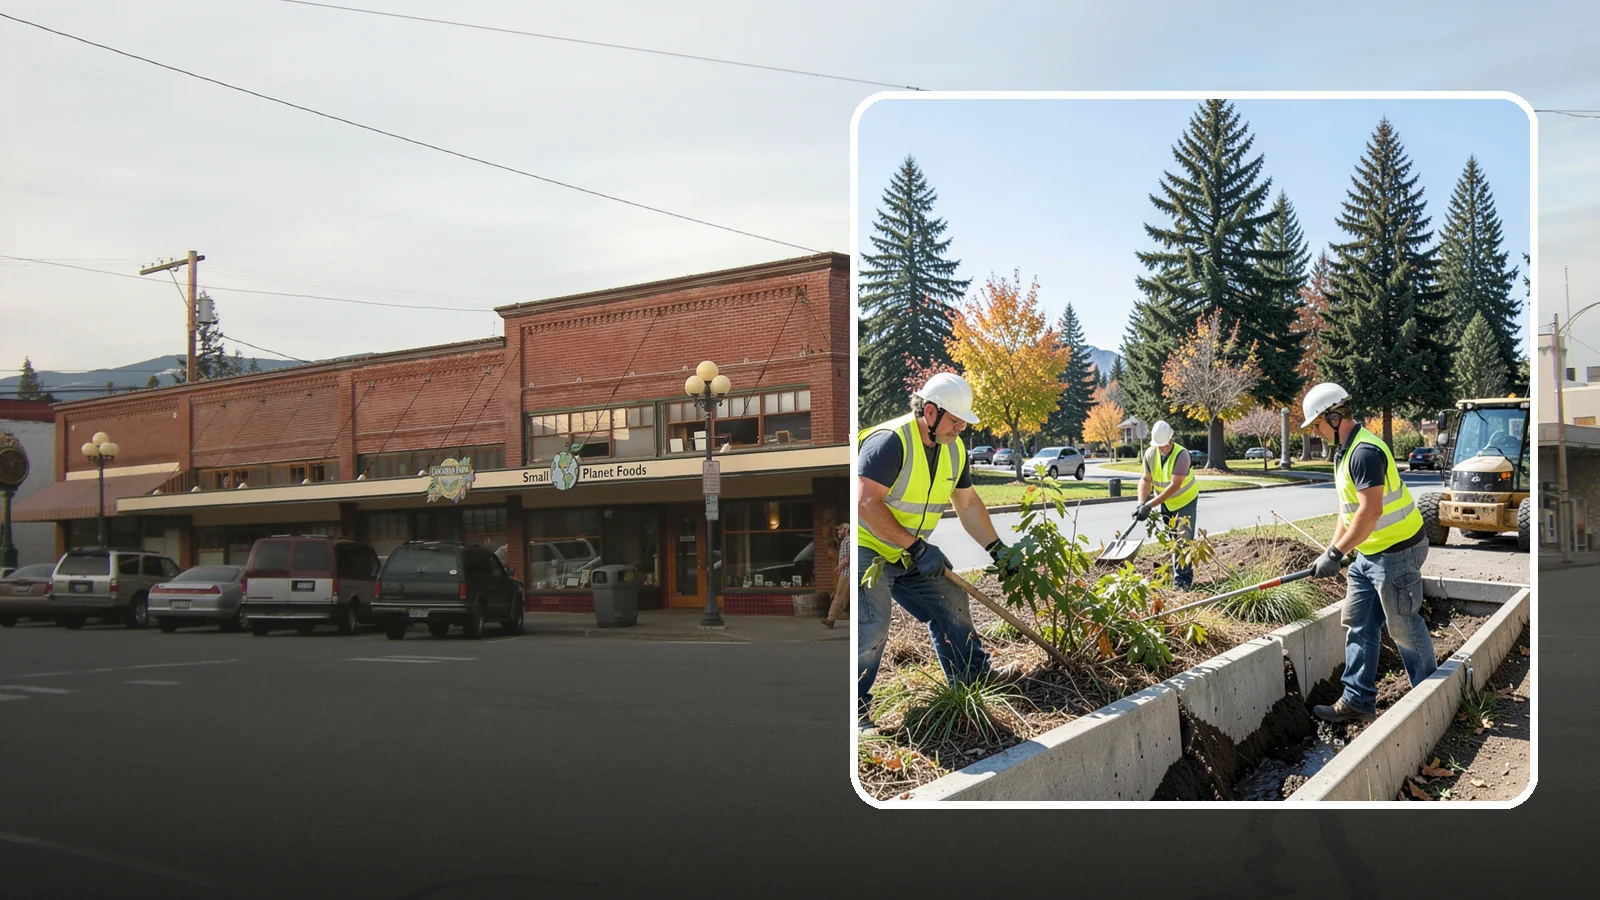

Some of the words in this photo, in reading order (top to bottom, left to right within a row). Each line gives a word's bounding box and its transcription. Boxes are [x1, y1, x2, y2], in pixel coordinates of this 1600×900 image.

[523, 471, 549, 483] Small
[582, 467, 614, 479] Planet
[617, 464, 647, 477] Foods
